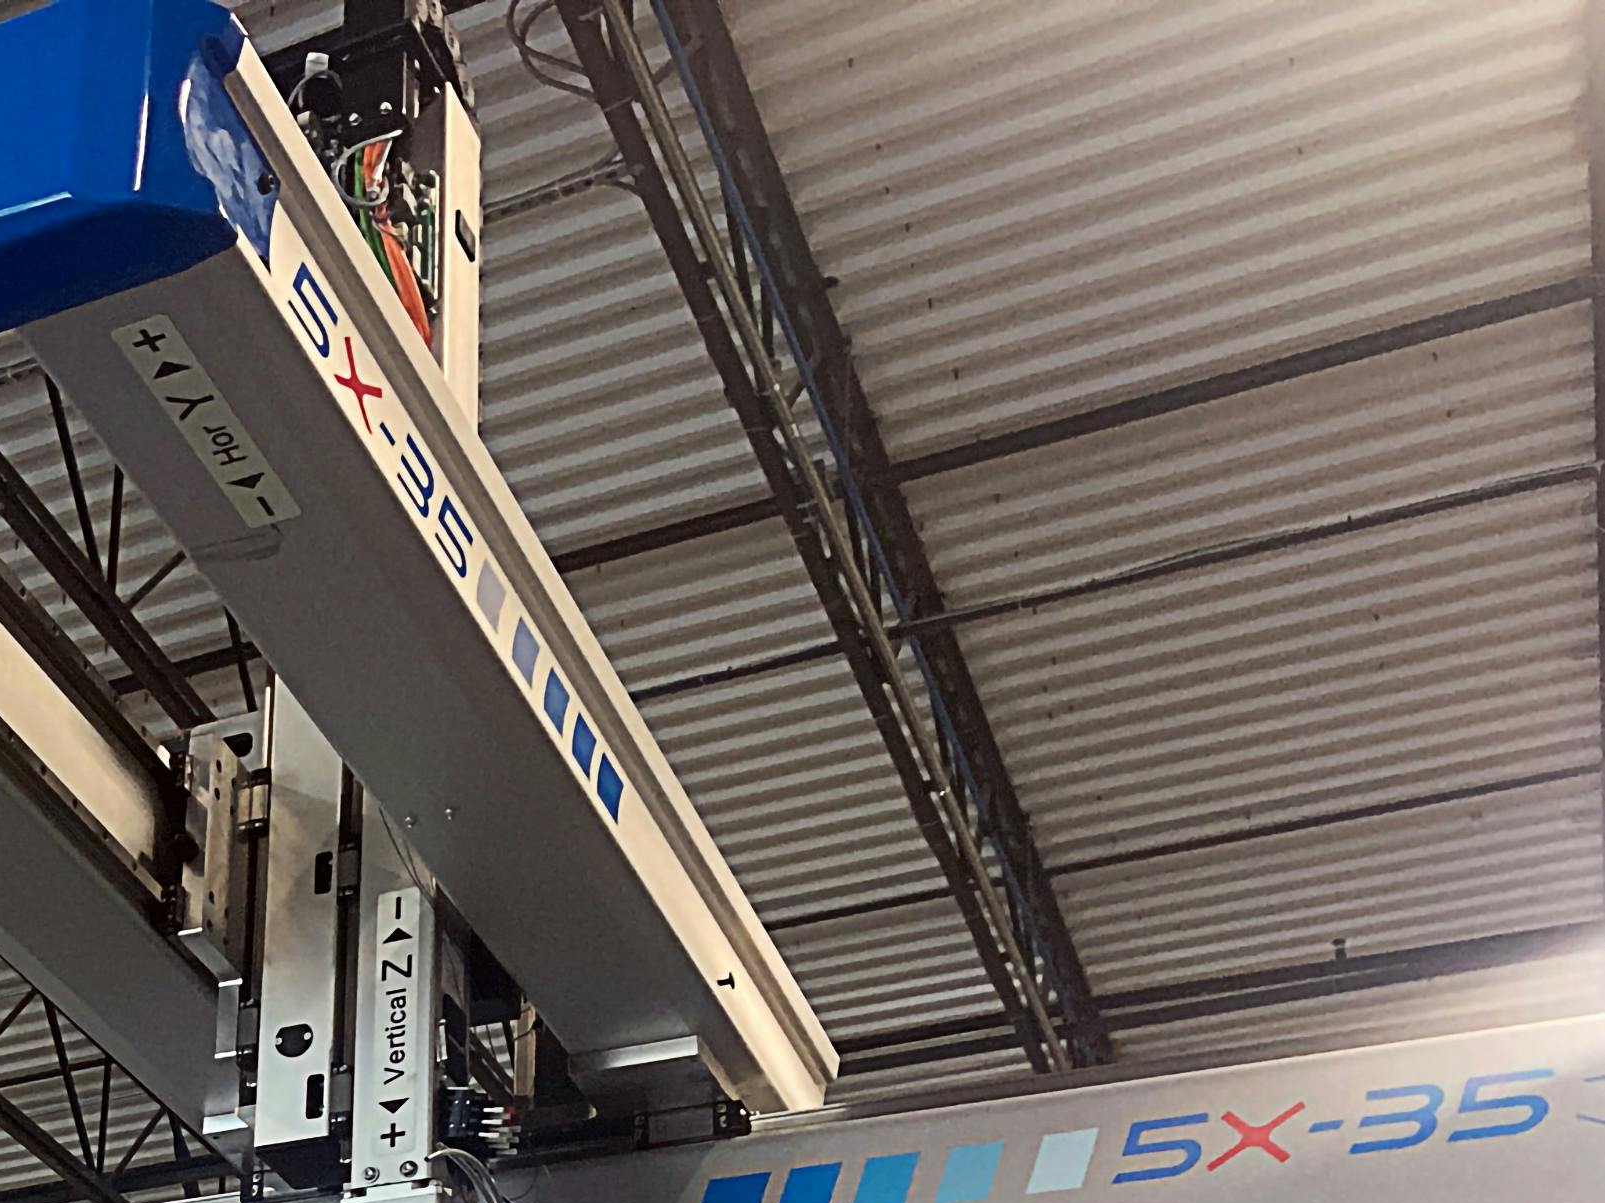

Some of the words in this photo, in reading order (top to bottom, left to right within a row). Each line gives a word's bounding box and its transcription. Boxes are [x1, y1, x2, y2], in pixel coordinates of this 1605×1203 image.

[165, 395, 214, 421] Y
[287, 261, 474, 578] 5X-35
[202, 425, 248, 466] Hor
[381, 954, 412, 982] Z
[383, 987, 407, 1086] Vertical
[1110, 1068, 1555, 1185] 5X-35
